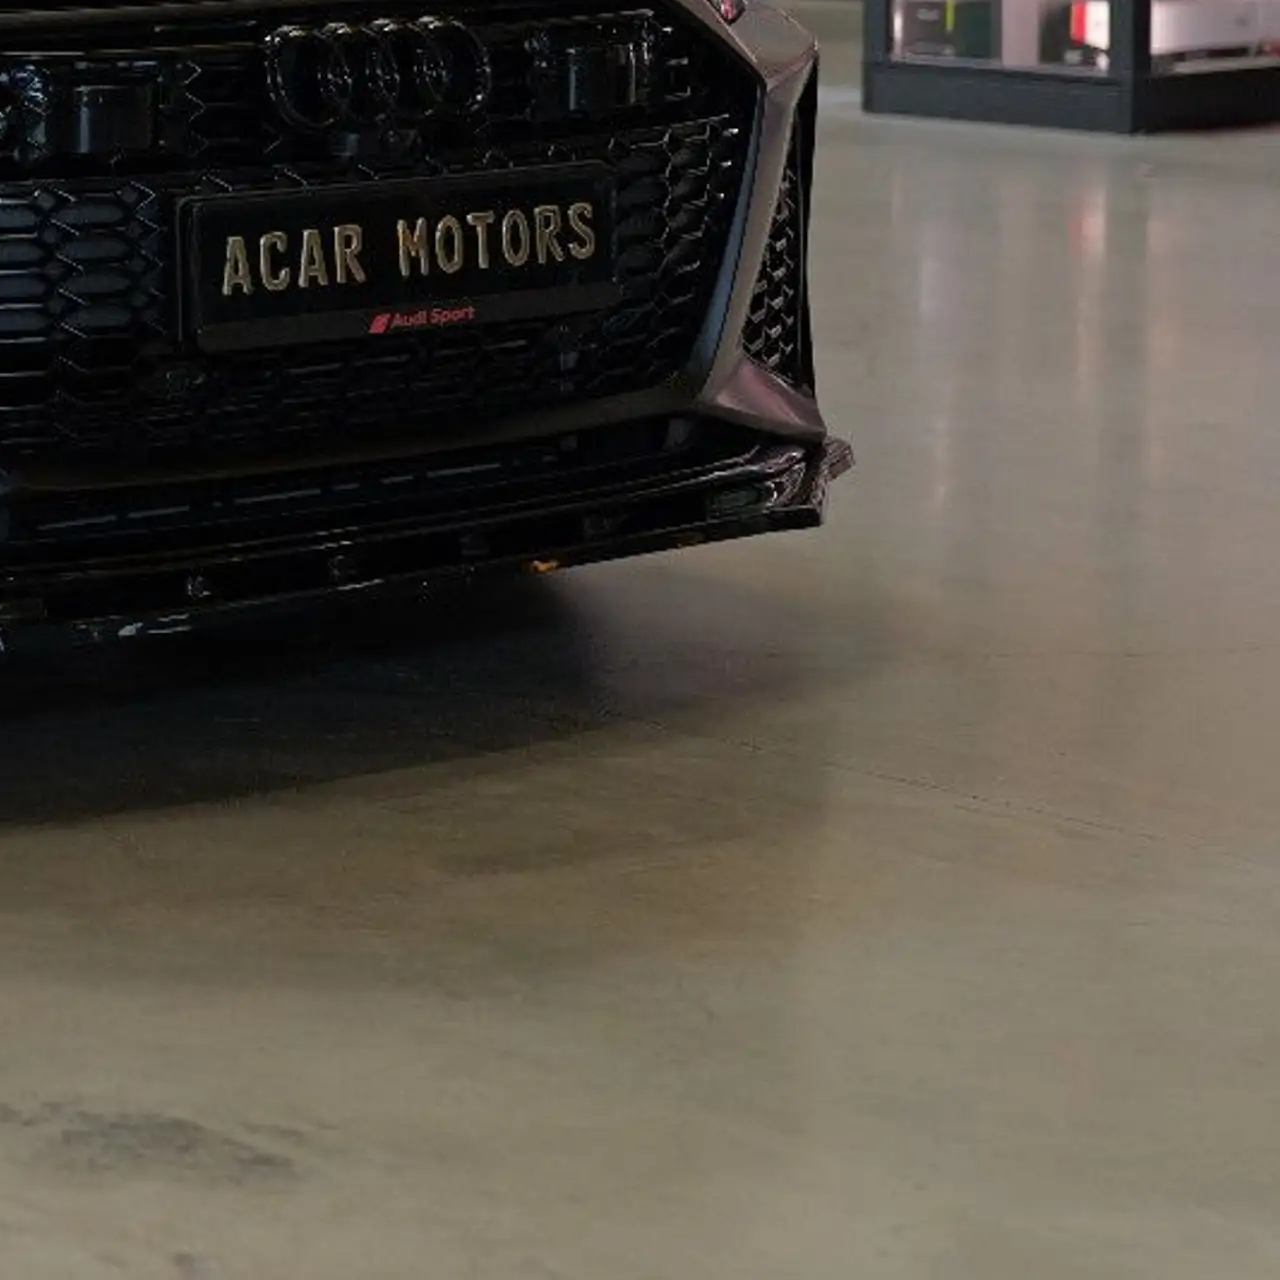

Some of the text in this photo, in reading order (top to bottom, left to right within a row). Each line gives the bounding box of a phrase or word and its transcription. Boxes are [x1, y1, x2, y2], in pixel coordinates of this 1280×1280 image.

[221, 201, 597, 296] ACAR MOTORS
[390, 305, 476, 328] Audi Sport
